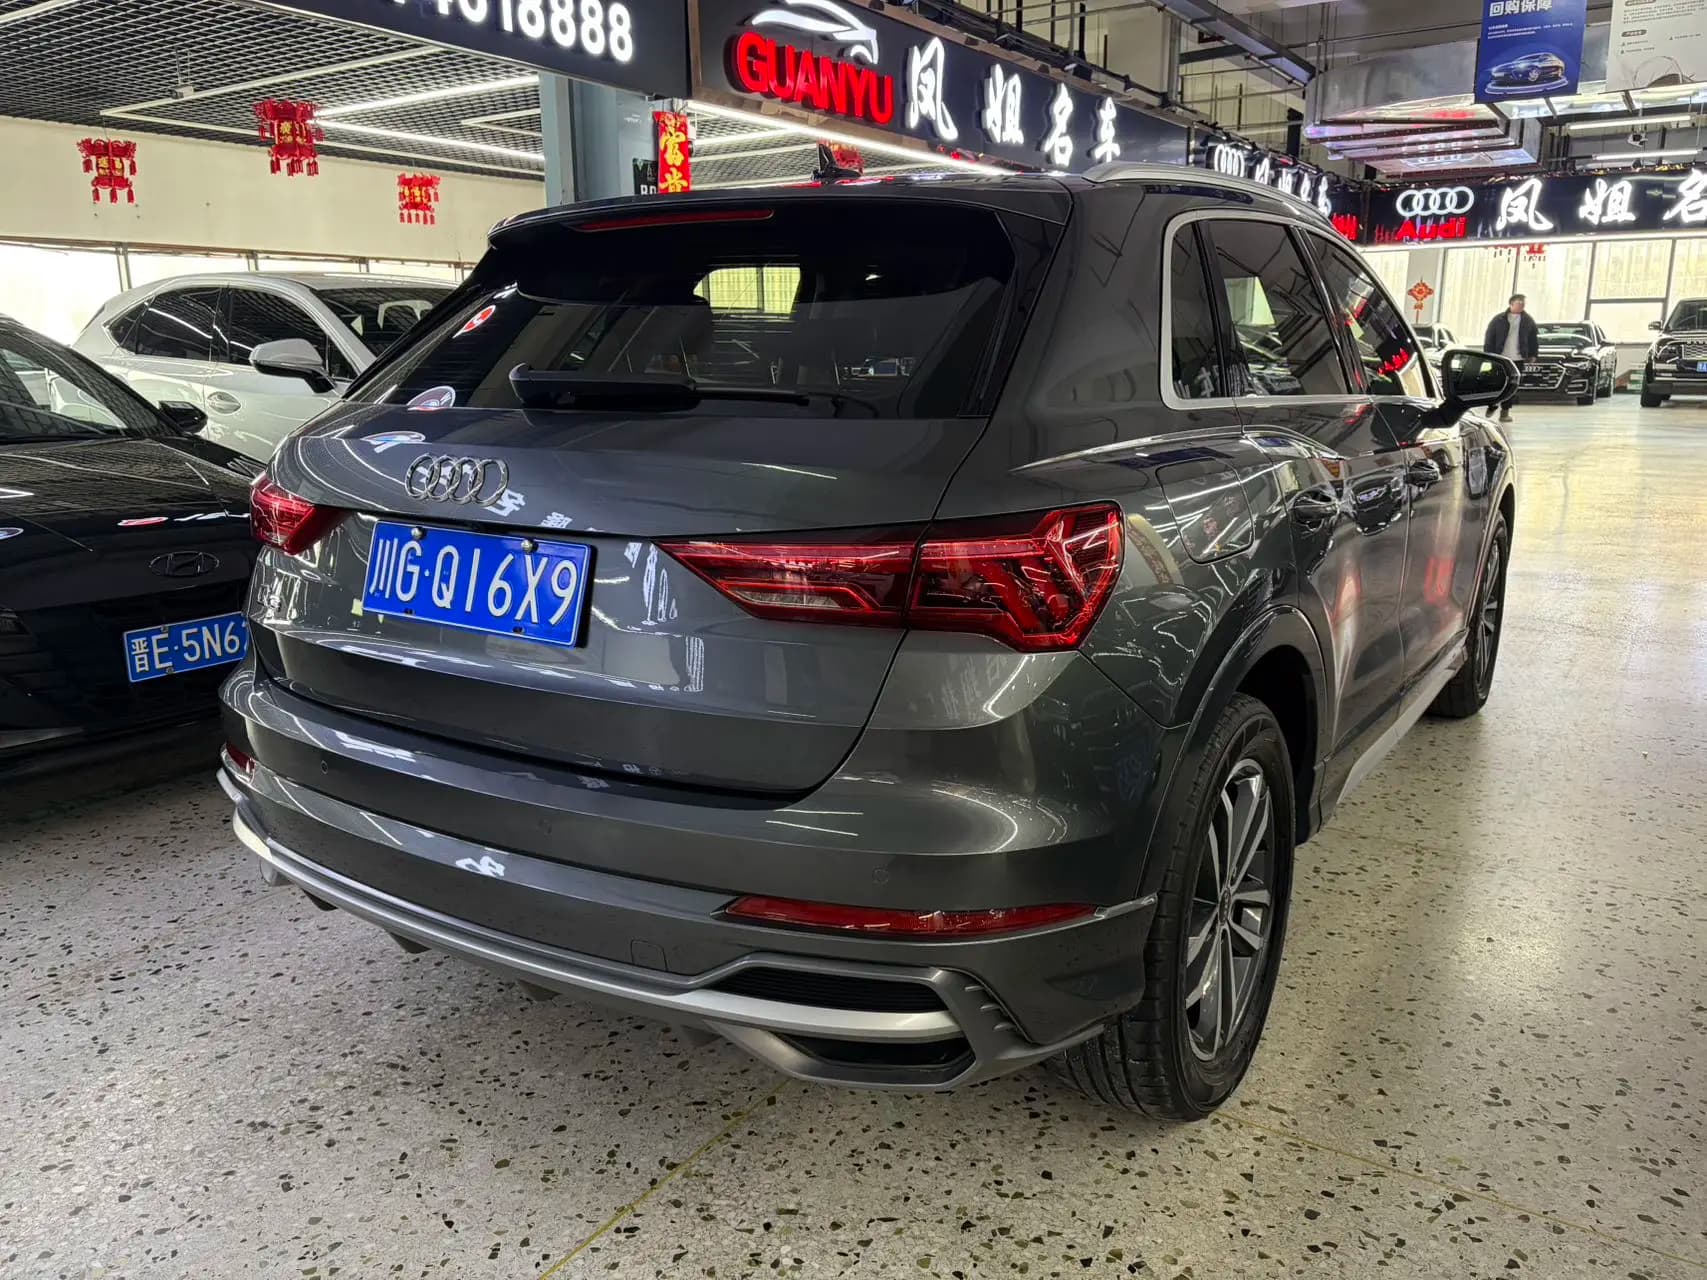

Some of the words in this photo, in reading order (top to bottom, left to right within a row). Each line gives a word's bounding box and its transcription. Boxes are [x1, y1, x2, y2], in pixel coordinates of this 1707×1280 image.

[1489, 0, 1552, 17] 回购保障
[736, 31, 894, 125] GUANYU
[1395, 216, 1468, 241] Audi
[131, 621, 247, 673] 晋E·5N6
